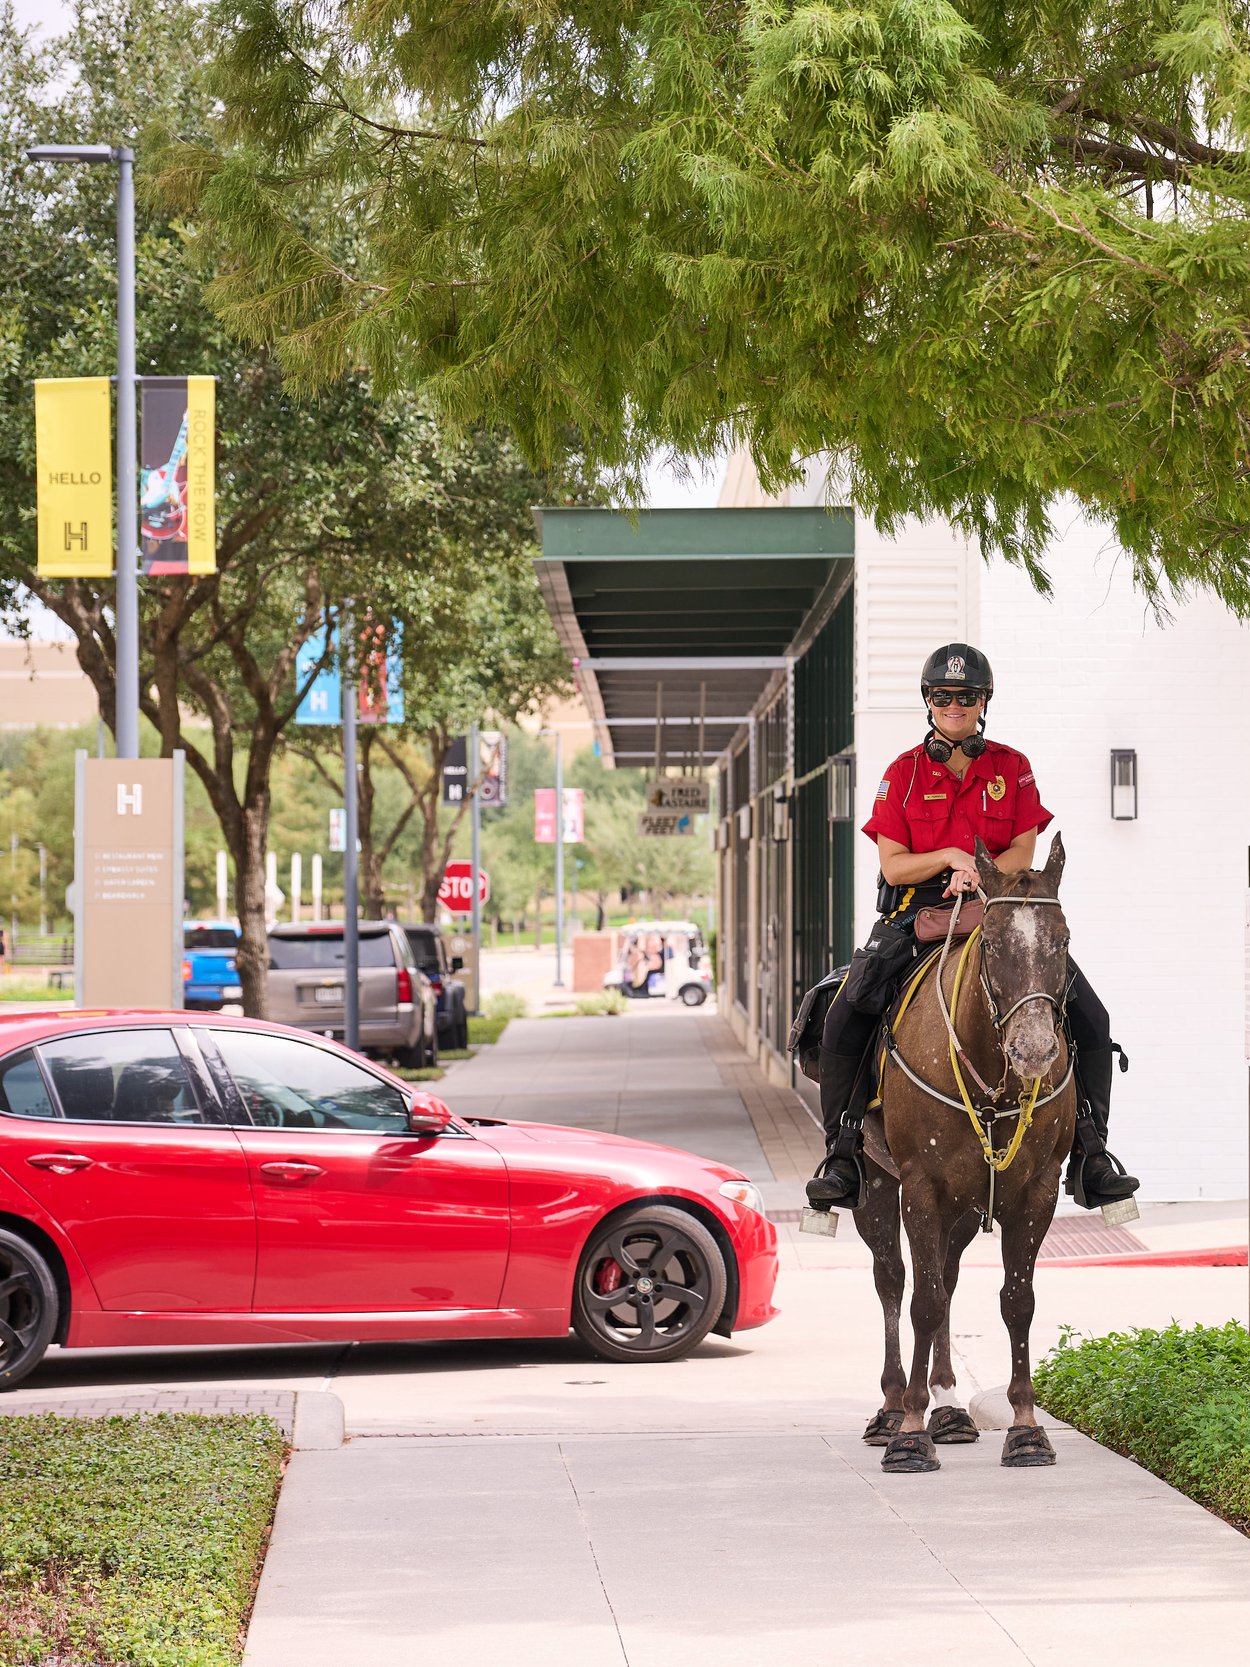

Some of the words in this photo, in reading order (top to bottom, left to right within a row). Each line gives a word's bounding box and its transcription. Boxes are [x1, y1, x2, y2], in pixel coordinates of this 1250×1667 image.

[193, 409, 207, 457] ROCK
[49, 471, 102, 485] HELLO
[193, 462, 207, 497] THE
[193, 502, 207, 542] ROW
[64, 521, 88, 551] H
[309, 689, 329, 713] H
[116, 783, 143, 816] H
[671, 787, 701, 797] FRED
[641, 815, 678, 827] FLEET
[645, 826, 676, 835] FEET
